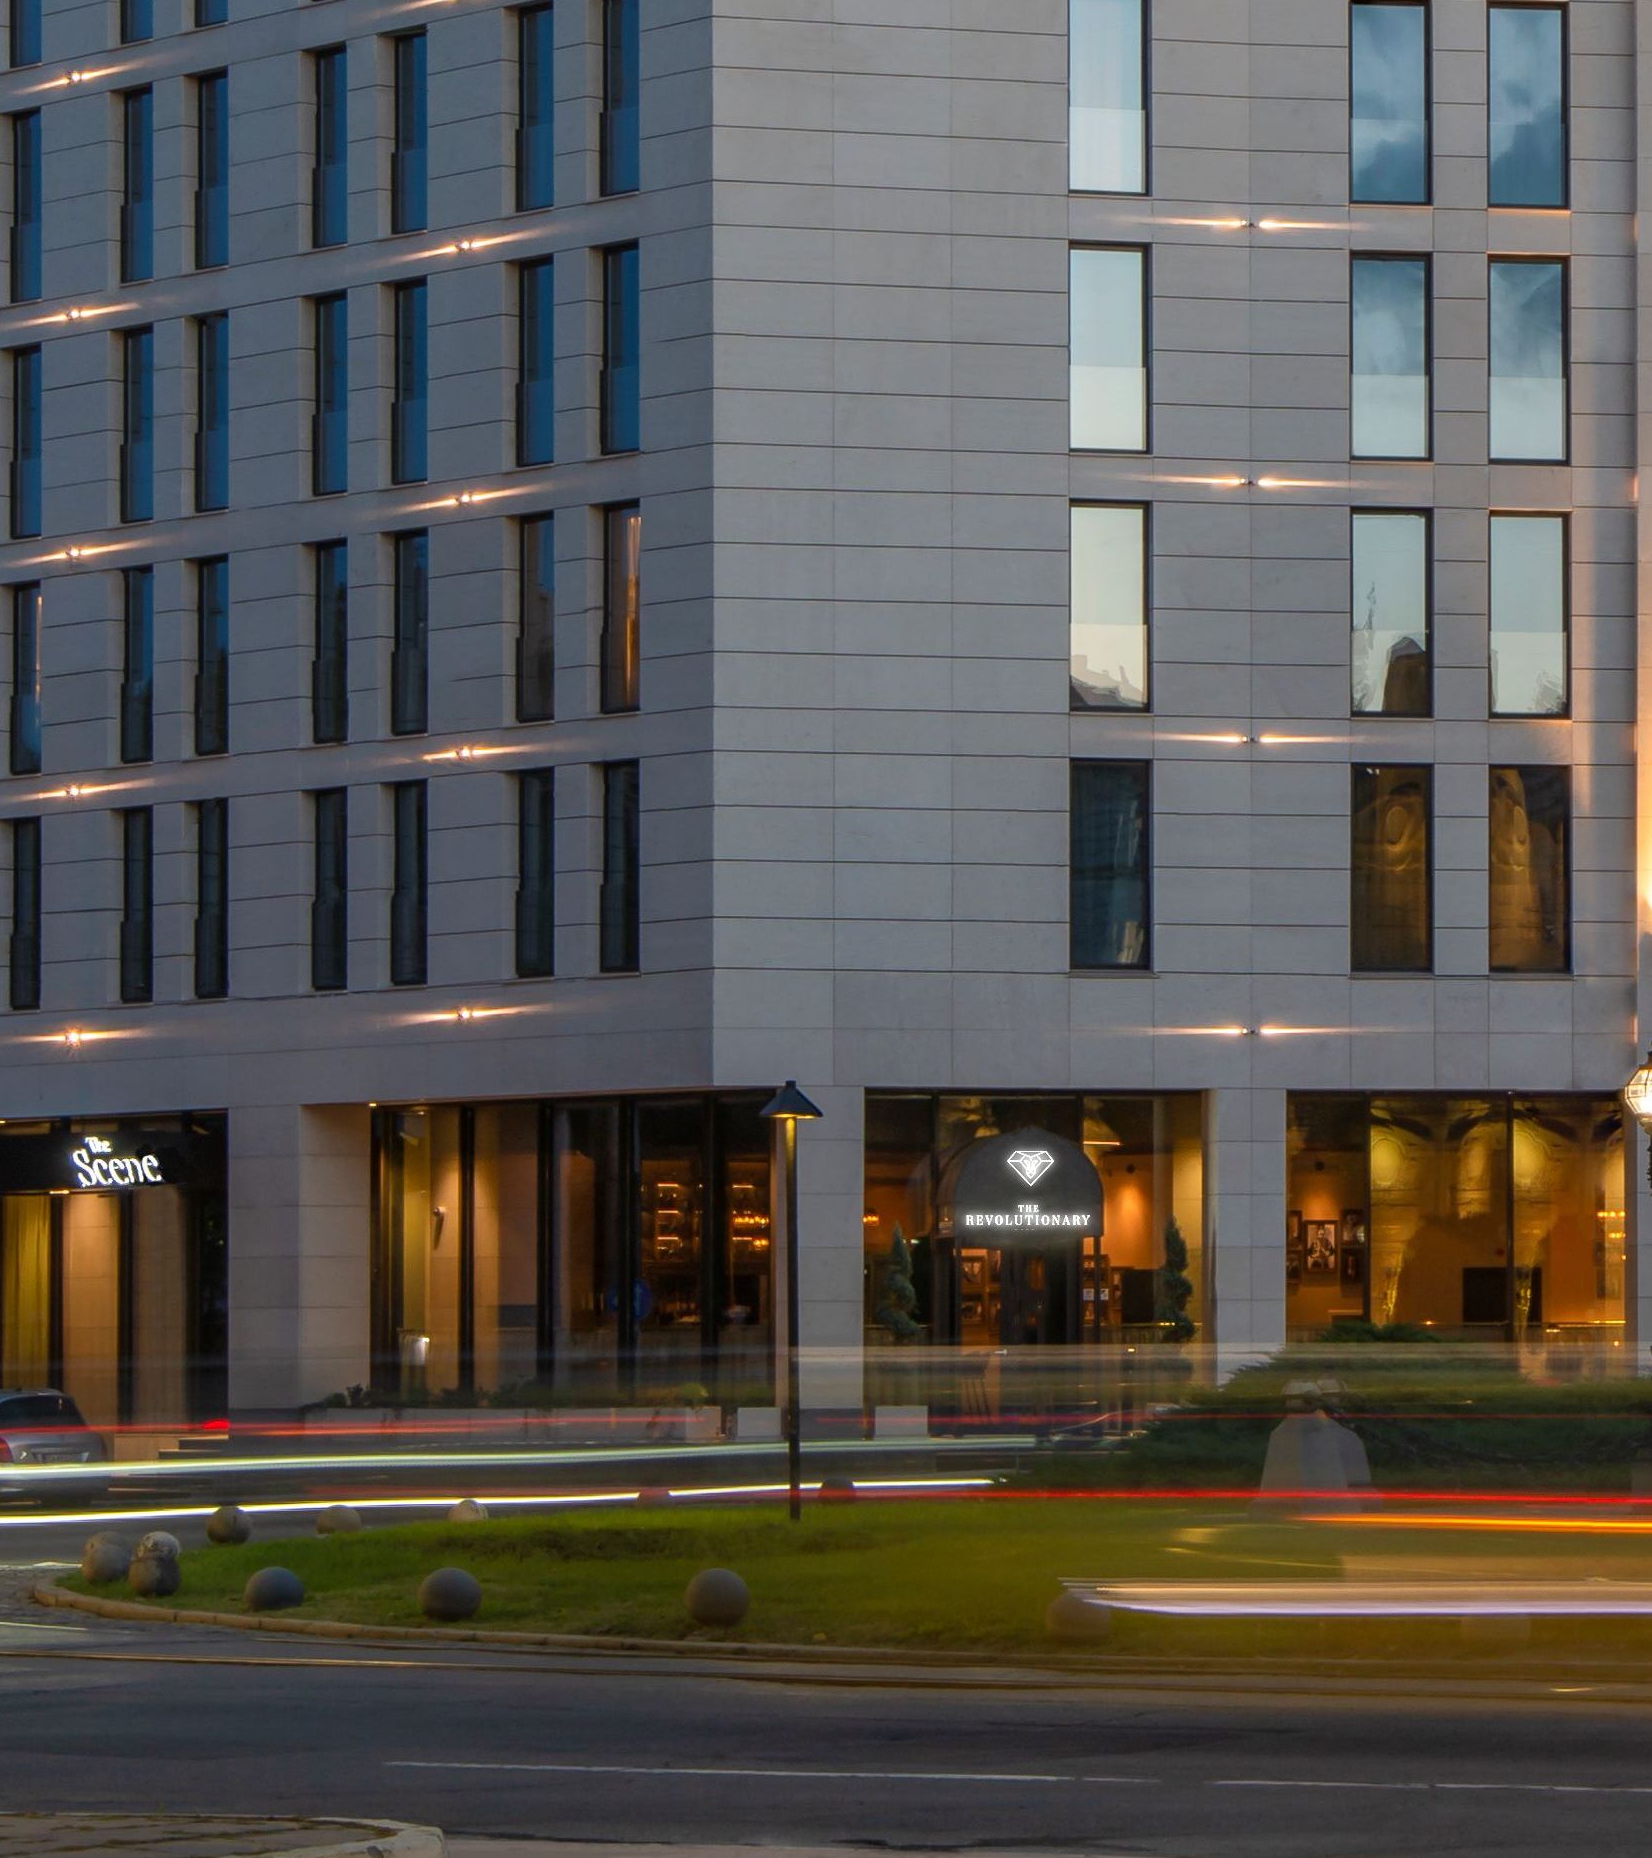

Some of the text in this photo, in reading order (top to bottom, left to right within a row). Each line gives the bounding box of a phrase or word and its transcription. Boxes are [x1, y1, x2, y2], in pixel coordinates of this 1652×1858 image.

[85, 1136, 112, 1153] The
[72, 1148, 162, 1187] Scene
[1017, 1204, 1040, 1213] THE
[965, 1214, 1091, 1226] REVOLUTIONARY
